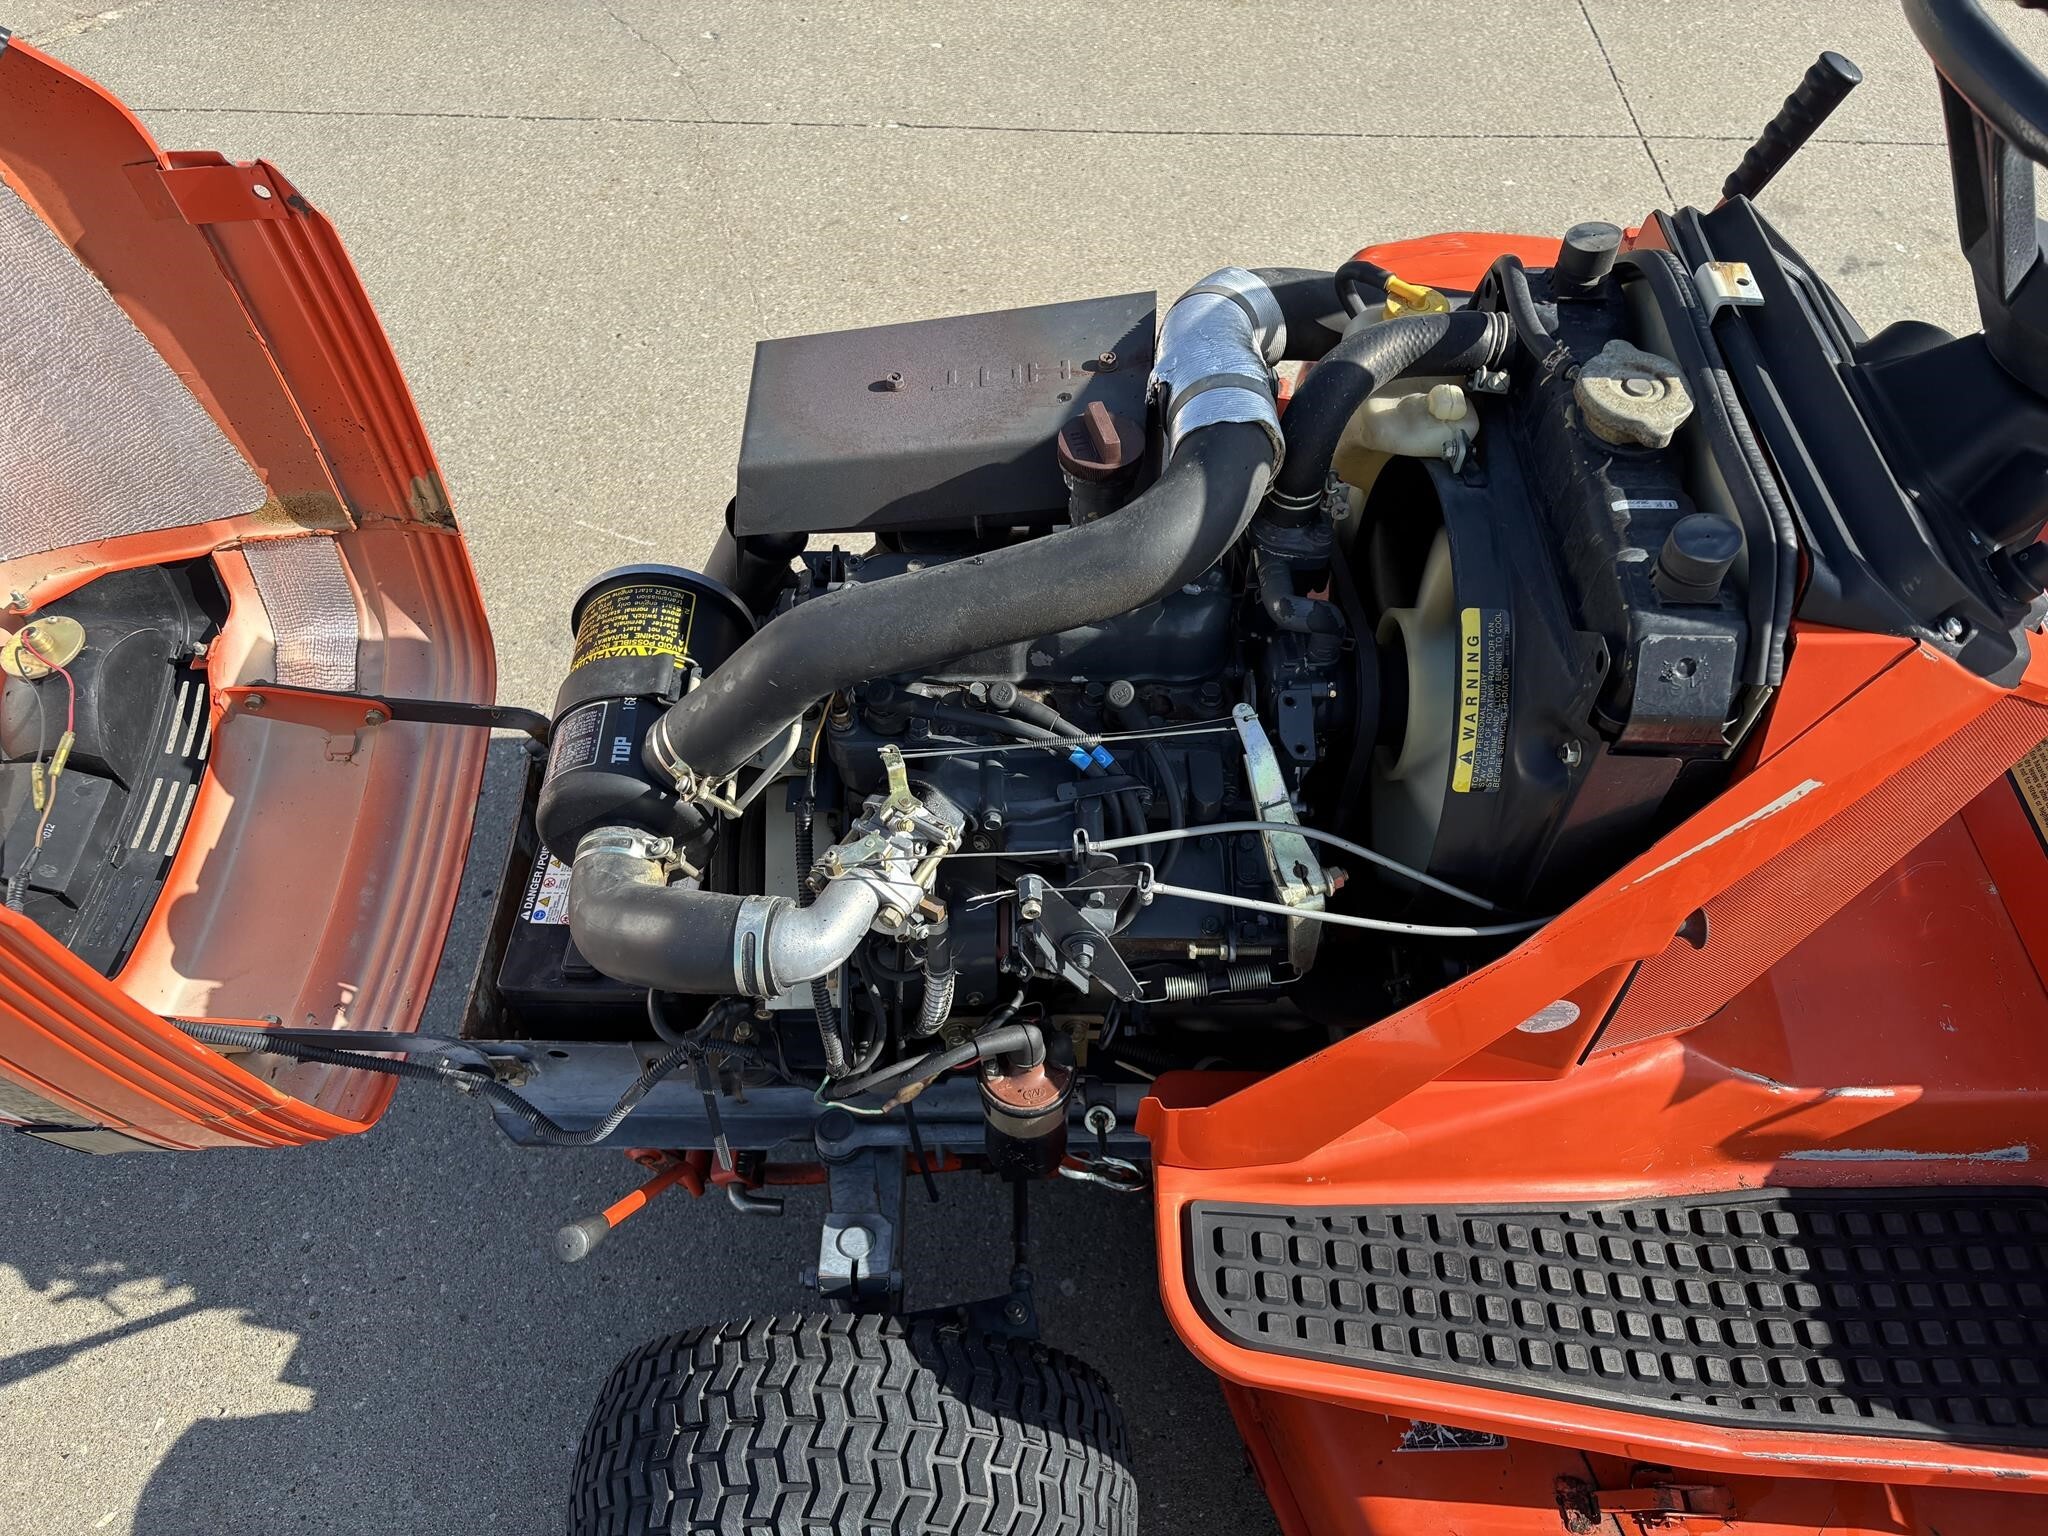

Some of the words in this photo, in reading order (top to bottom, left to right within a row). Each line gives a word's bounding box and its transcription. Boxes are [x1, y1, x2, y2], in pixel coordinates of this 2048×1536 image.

[634, 633, 674, 644] MACHINE
[658, 641, 684, 652] AVOID
[1496, 637, 1502, 647] TO
[1462, 636, 1479, 740] WARNING
[1487, 684, 1495, 724] ROTATING
[1476, 706, 1486, 748] PERSONAL
[1484, 727, 1491, 738] OF
[1497, 712, 1507, 755] SERVICING
[610, 736, 633, 765] TOP
[1474, 751, 1482, 774] AVOID
[1481, 740, 1490, 766] CLEAR
[1489, 736, 1498, 764] ENGINE
[1478, 769, 1486, 787] STAY
[1486, 767, 1494, 787] STOP
[1493, 757, 1503, 788] BEFORE
